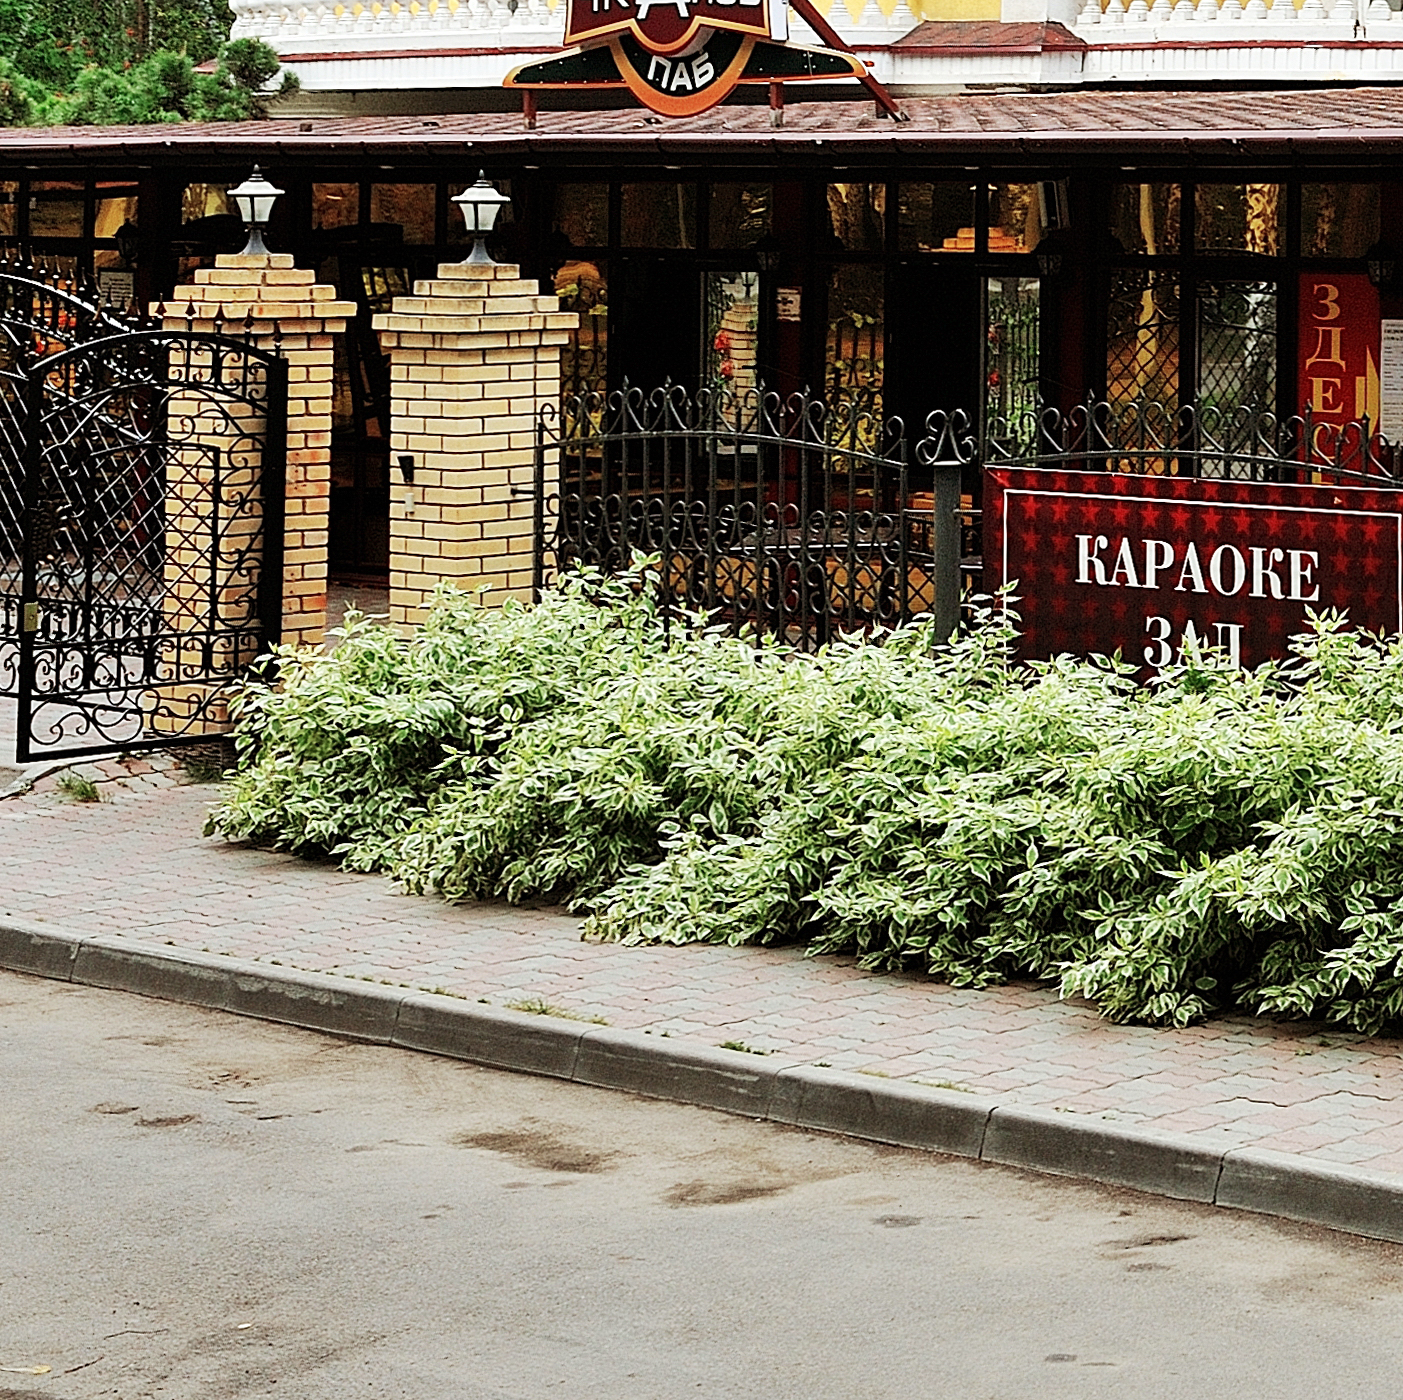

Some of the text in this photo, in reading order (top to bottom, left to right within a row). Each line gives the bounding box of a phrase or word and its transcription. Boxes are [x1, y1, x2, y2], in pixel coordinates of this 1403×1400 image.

[647, 51, 715, 92] ПАБ
[1074, 534, 1320, 602] КАРАОКЕ
[1143, 616, 1245, 672] ЗАЛ
